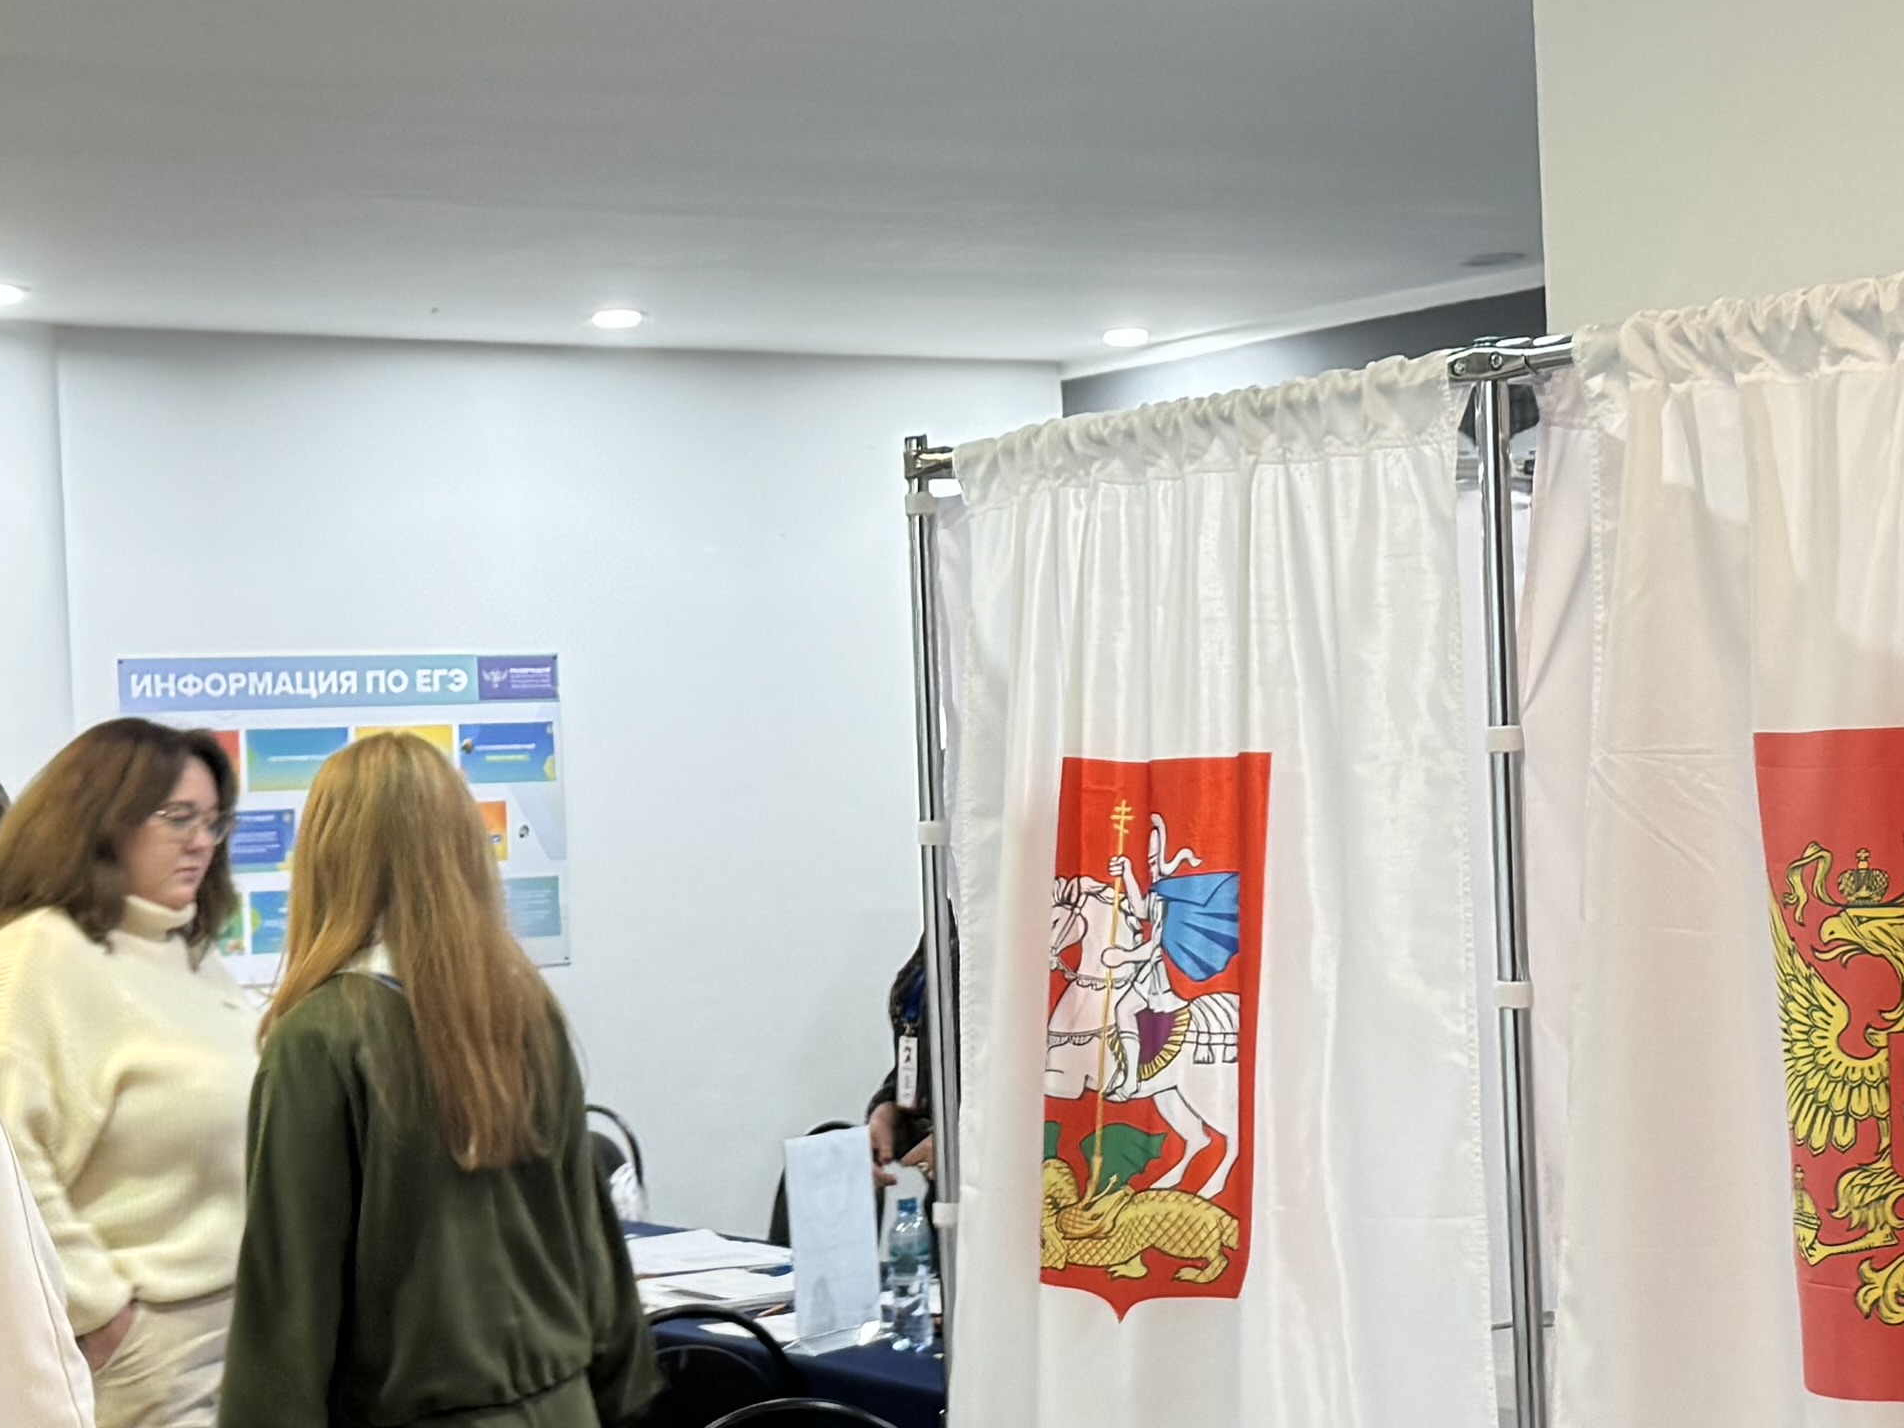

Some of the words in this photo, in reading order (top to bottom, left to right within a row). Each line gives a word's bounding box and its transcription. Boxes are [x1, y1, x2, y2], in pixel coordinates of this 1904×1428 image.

[130, 671, 357, 699] ИНФОРМАЦИЯ
[367, 670, 408, 694] ПО
[416, 668, 469, 693] ЕГЭ
